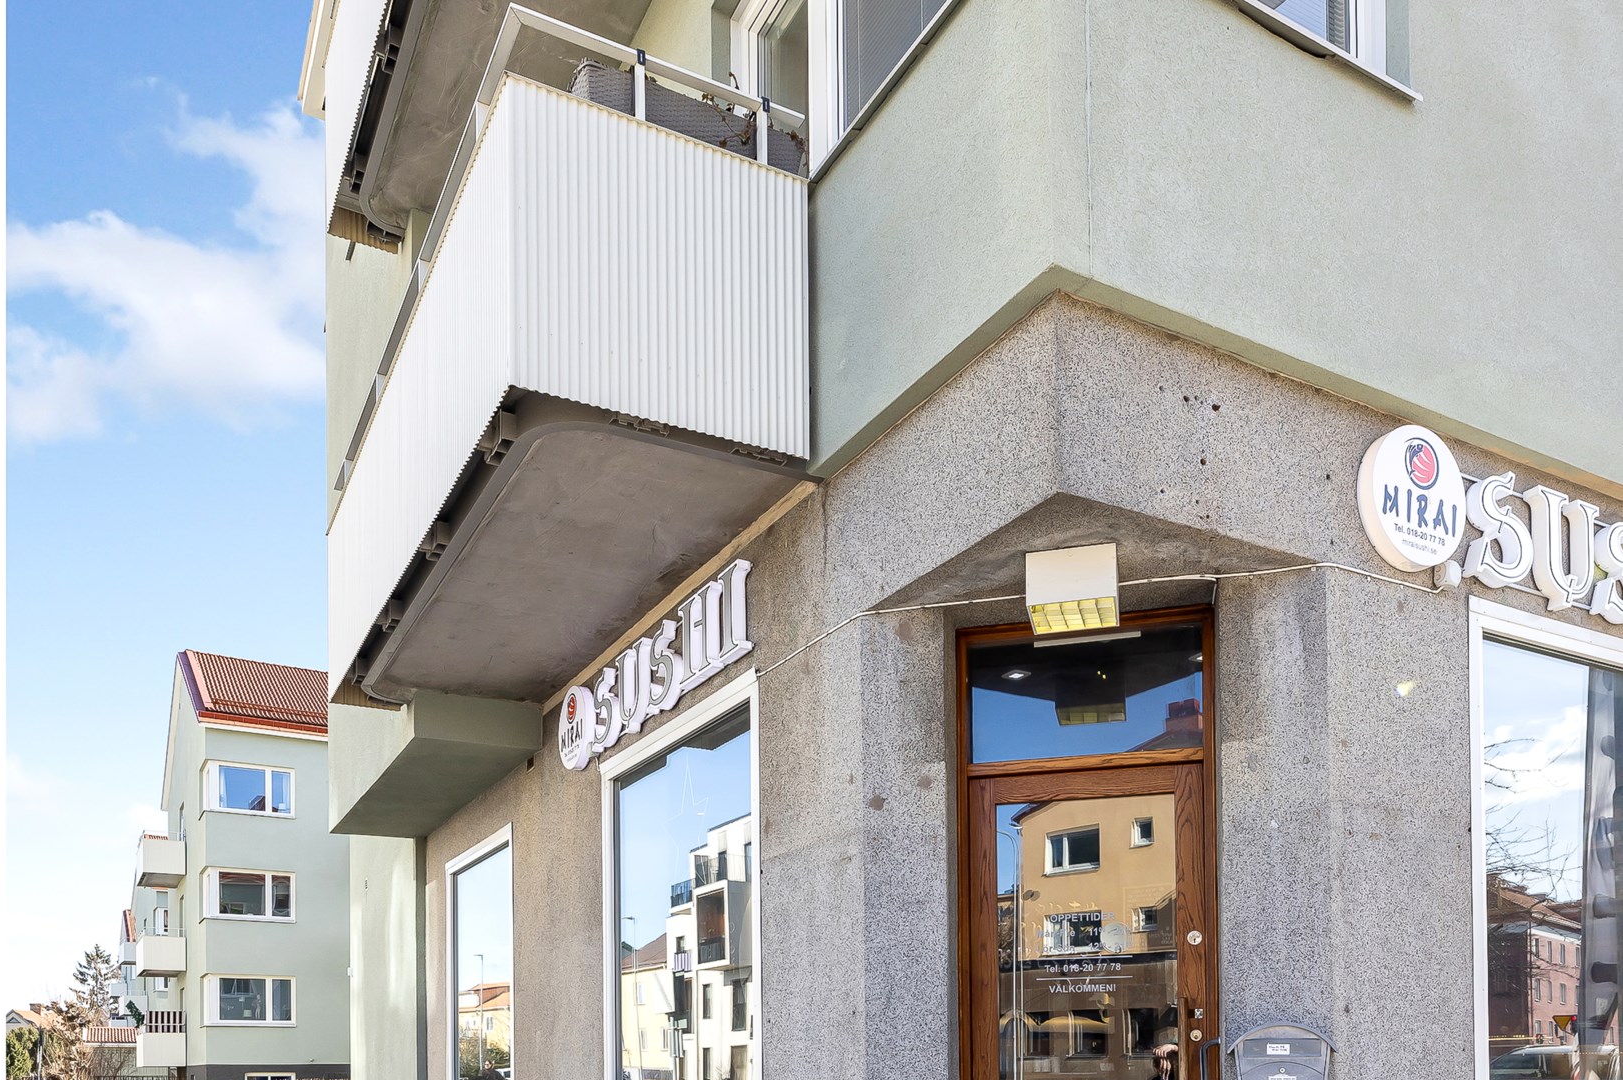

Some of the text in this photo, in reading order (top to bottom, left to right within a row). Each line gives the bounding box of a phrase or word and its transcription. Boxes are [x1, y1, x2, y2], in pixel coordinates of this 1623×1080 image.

[1382, 484, 1457, 538] MIRAI
[1394, 523, 1446, 546] Tel. 018-20 77 78
[593, 559, 754, 753] SUSHI
[1097, 963, 1108, 971] 77
[1110, 963, 1122, 971] 78
